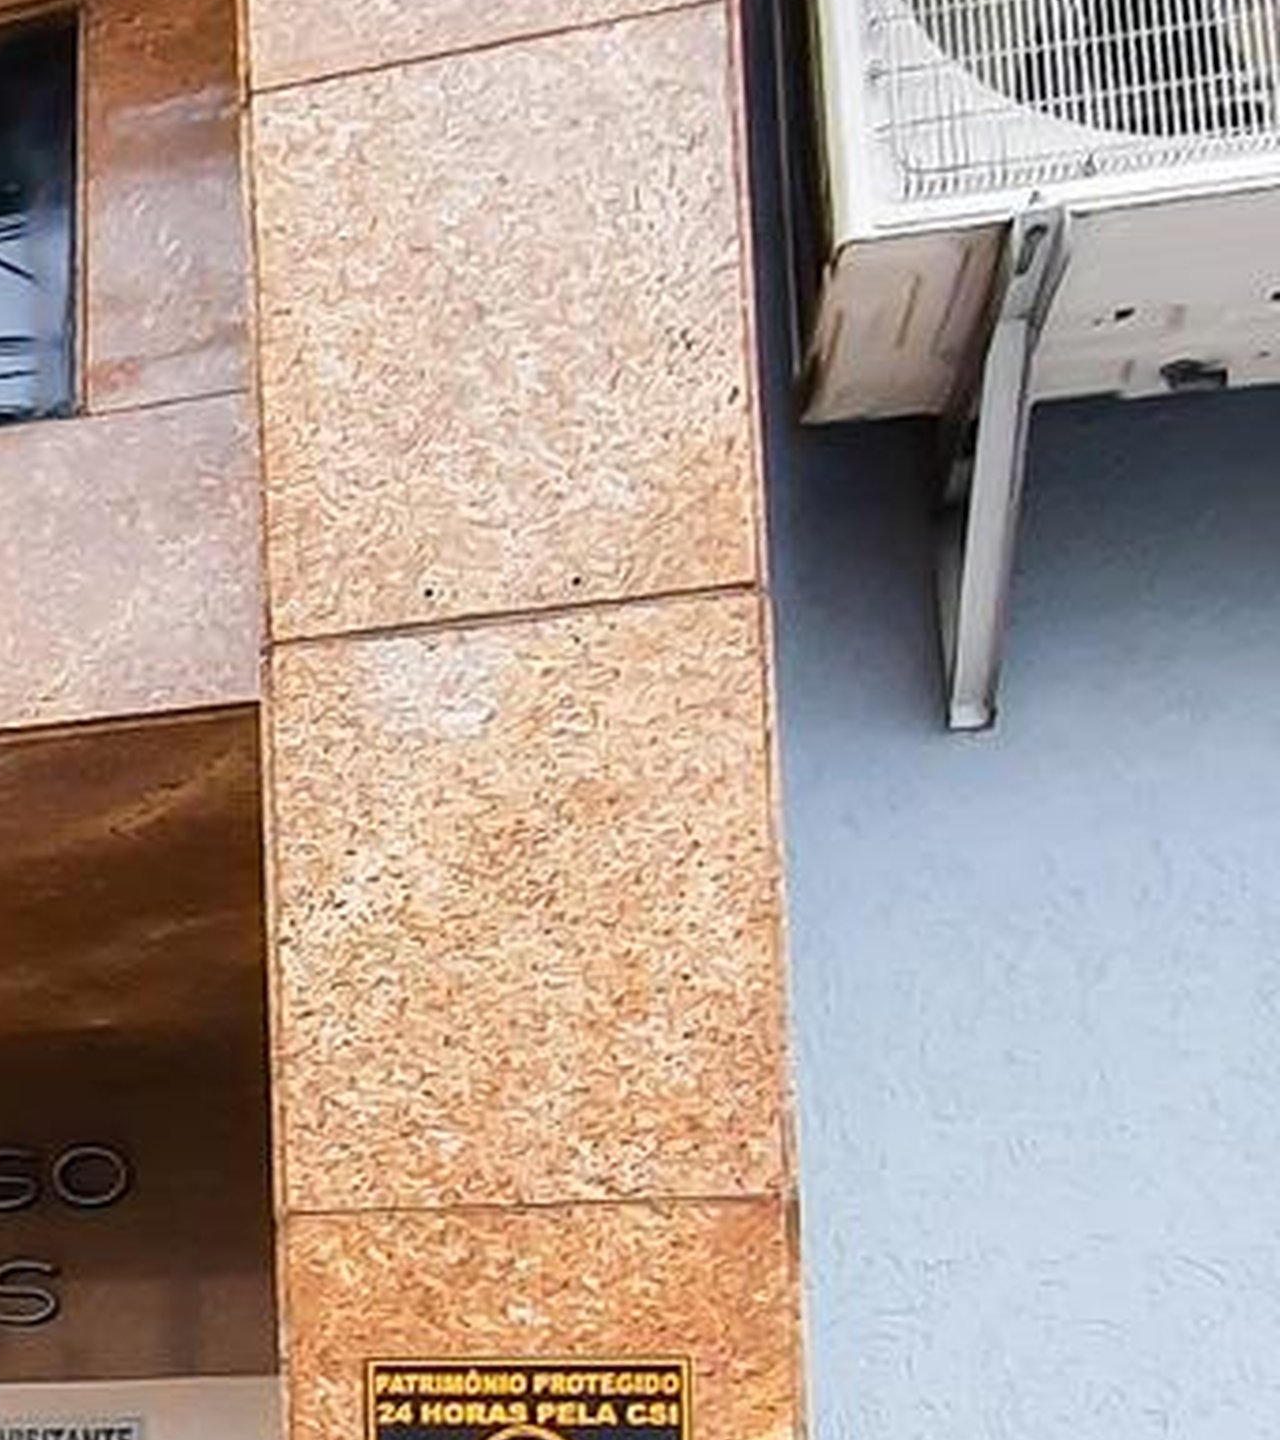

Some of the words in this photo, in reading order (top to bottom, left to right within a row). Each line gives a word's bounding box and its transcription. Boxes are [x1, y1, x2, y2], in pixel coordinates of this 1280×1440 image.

[533, 1371, 681, 1395] PROTEGIDO
[376, 1401, 414, 1425] 24
[420, 1401, 528, 1426] HORAS
[536, 1401, 618, 1427] PELA
[626, 1403, 679, 1427] CSI
